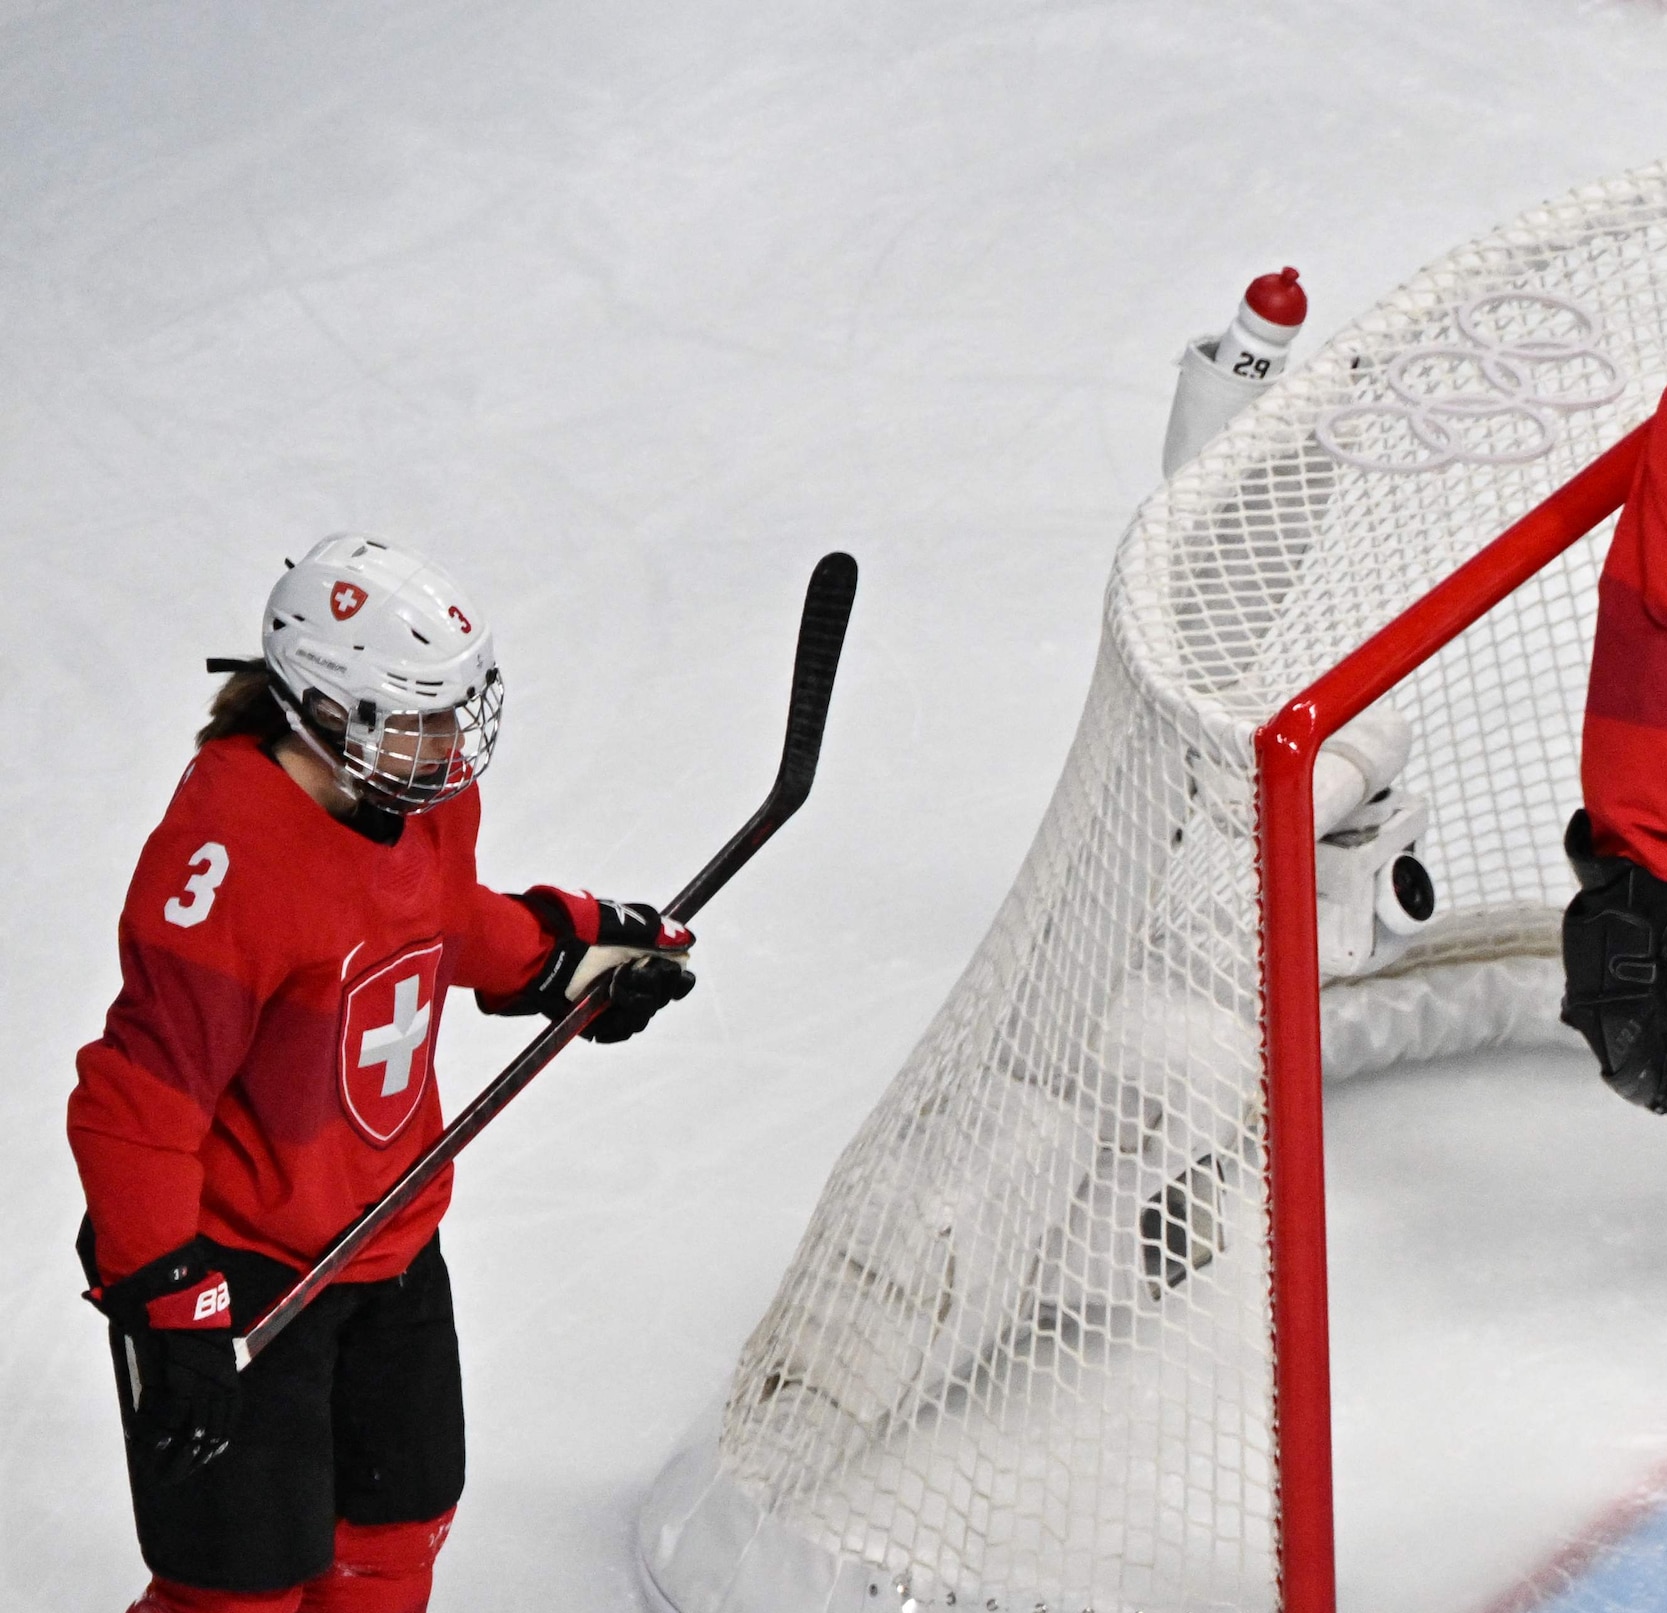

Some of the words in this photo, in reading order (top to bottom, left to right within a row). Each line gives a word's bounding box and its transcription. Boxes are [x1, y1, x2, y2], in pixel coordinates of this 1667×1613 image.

[1233, 351, 1270, 379] 29
[448, 605, 472, 634] 3
[163, 841, 230, 929] 3
